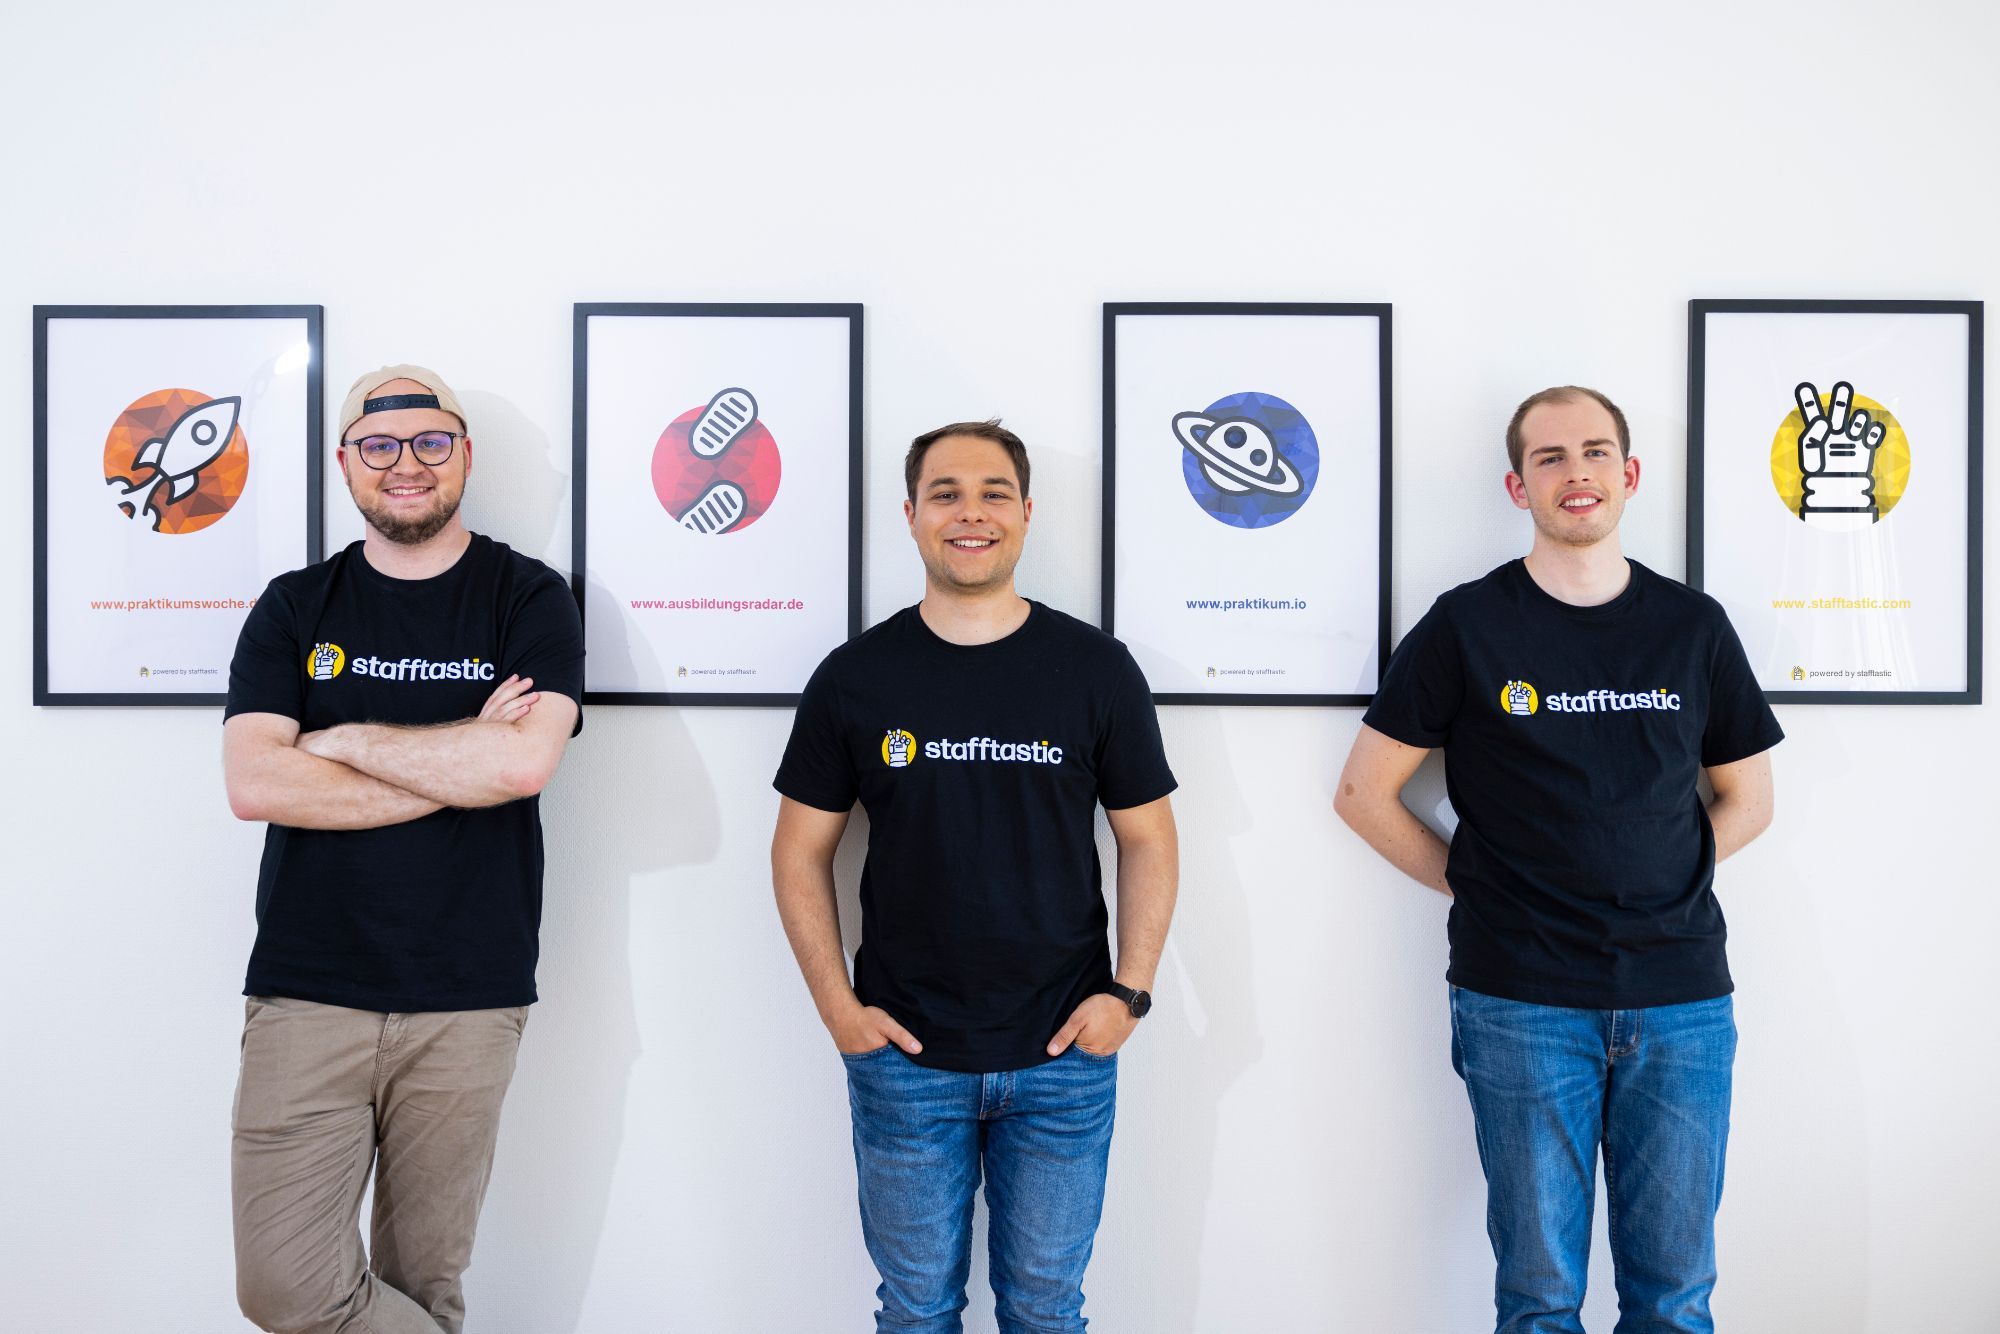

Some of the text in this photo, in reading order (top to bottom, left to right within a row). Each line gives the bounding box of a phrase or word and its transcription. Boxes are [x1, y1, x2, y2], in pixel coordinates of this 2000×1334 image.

[630, 597, 804, 613] www.ausbildungsradar.de
[1185, 597, 1307, 612] www.praktikum.io
[1772, 597, 1911, 609] www.stafftastic.com
[351, 655, 495, 681] stafftastic
[1809, 669, 1892, 679] powered by stafftastic
[1545, 688, 1681, 713] stafftastic
[924, 736, 1063, 765] stafftastic
